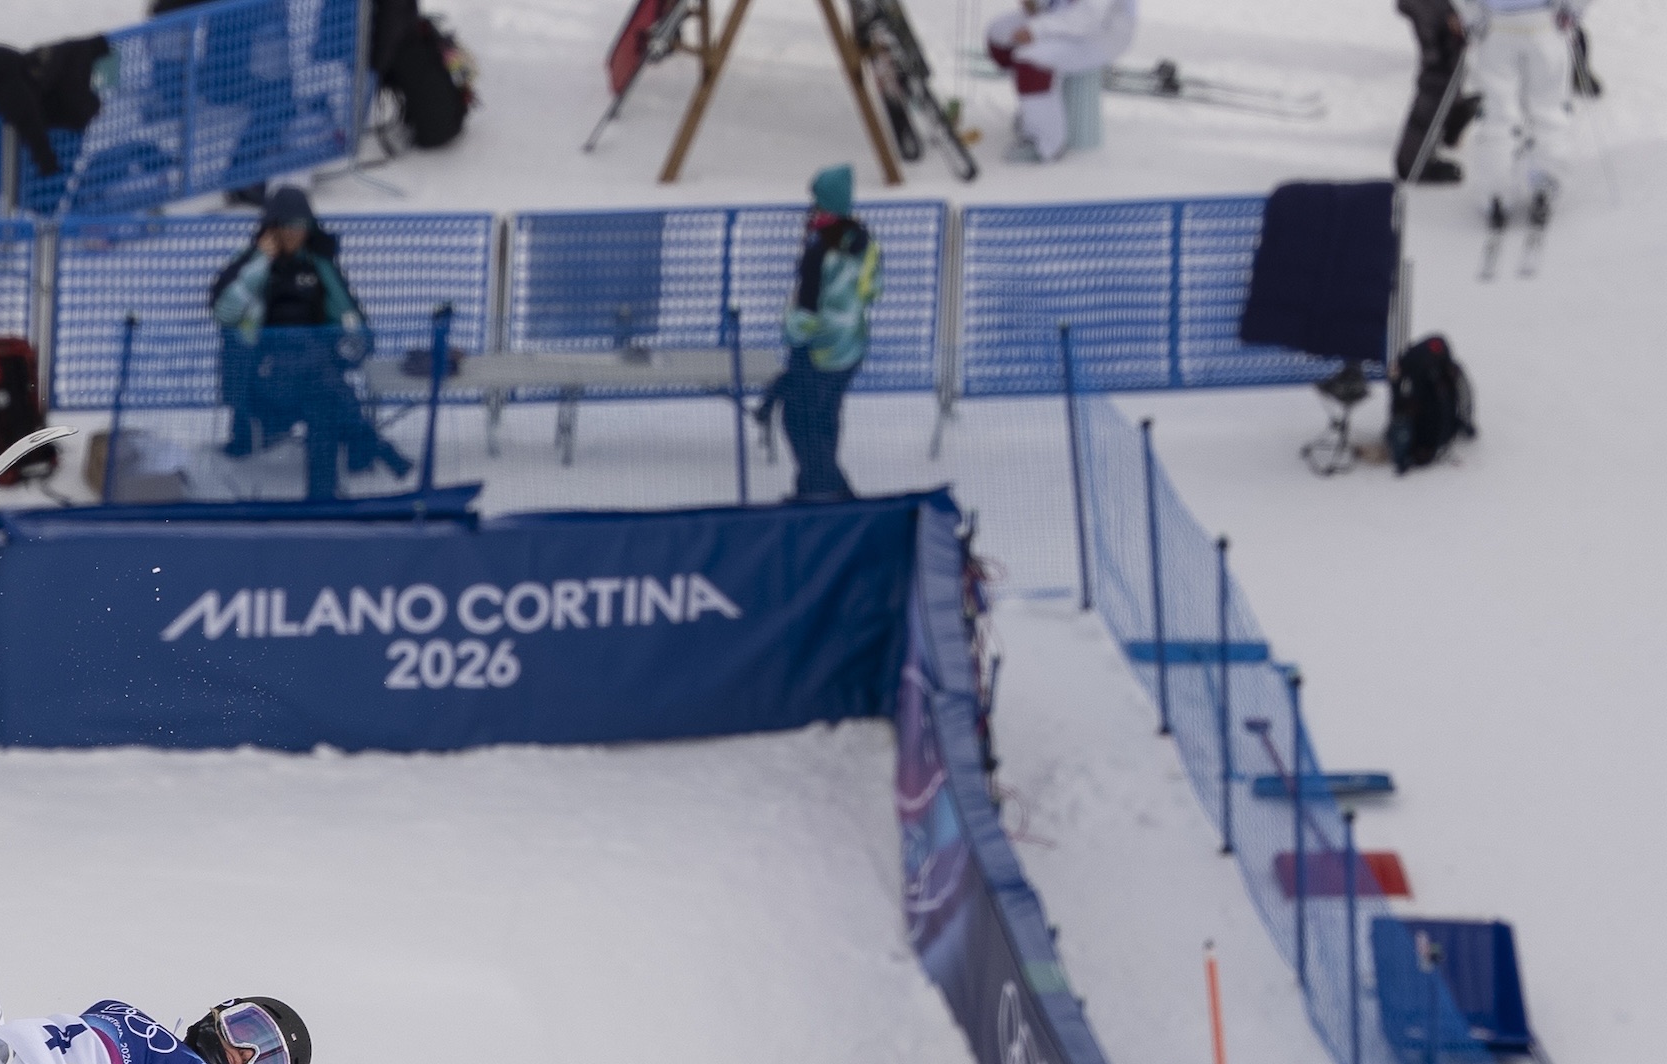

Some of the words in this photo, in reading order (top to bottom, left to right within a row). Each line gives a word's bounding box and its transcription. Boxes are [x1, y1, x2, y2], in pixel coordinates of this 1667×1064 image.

[161, 584, 447, 641] MILANO
[456, 573, 744, 634] CORTINA
[385, 639, 521, 689] 2026
[120, 1042, 132, 1064] 2026
